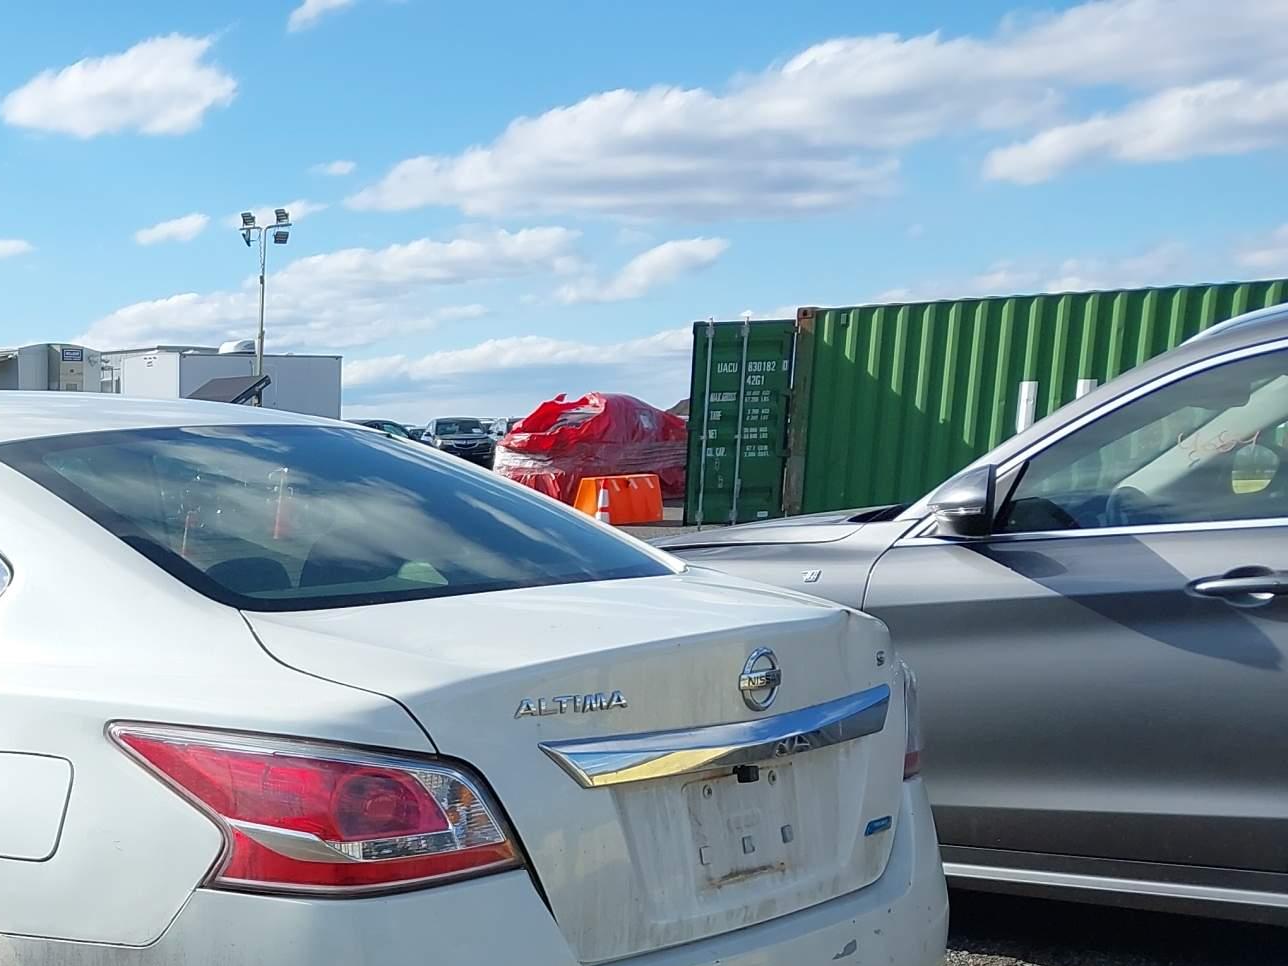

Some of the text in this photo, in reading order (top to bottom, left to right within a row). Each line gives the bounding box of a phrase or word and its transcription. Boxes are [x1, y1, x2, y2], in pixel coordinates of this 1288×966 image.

[717, 362, 738, 373] UACU
[747, 361, 776, 372] 830182
[746, 375, 765, 385] 42G1
[876, 650, 886, 667] S
[513, 690, 628, 720] ALTIMA
